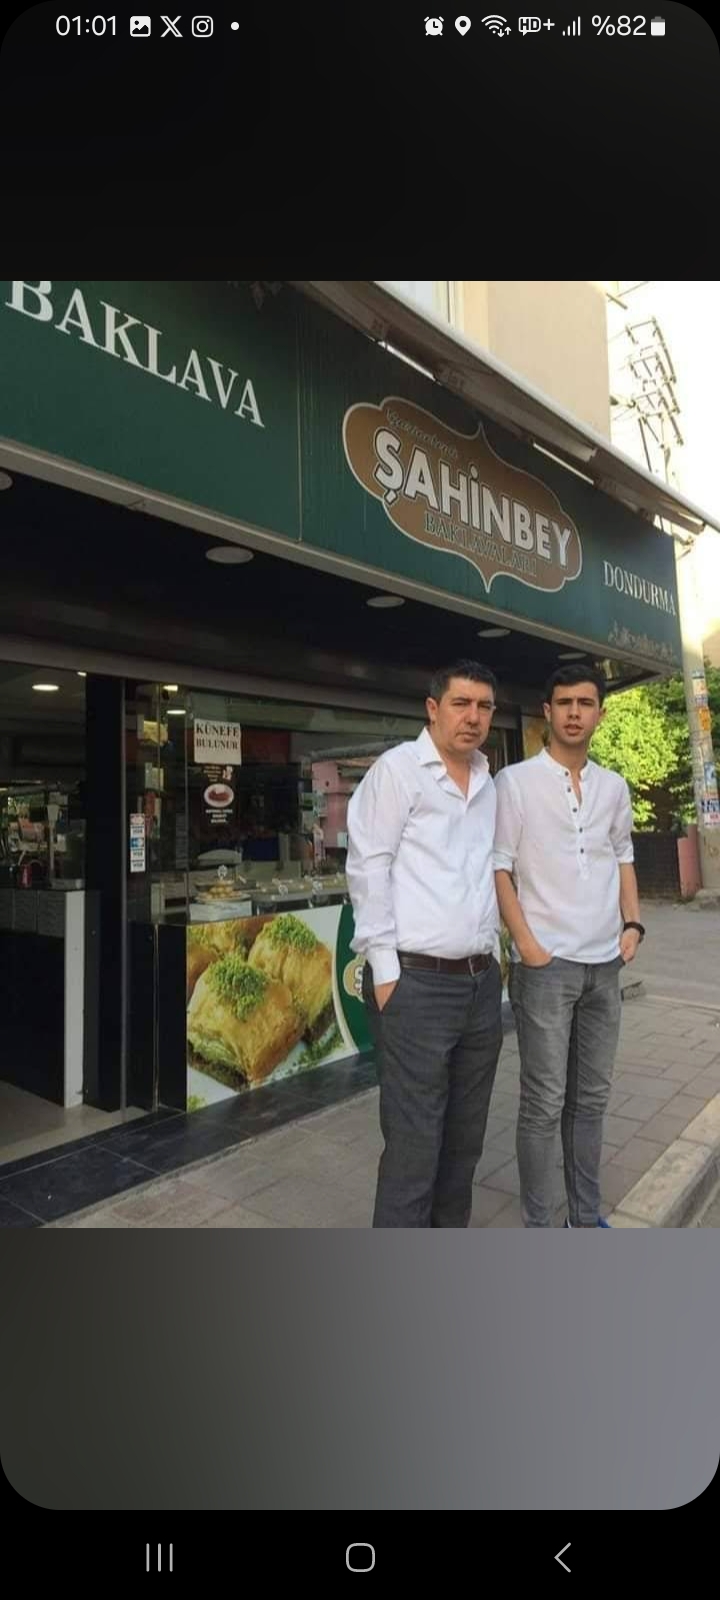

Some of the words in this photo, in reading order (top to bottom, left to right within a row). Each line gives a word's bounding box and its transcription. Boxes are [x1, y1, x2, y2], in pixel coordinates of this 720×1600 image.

[5, 281, 266, 428] BAKLAVA
[424, 510, 538, 577] BAKLAVALARI
[603, 559, 677, 616] DONDURMA
[195, 721, 240, 738] KÜNEFE
[195, 737, 239, 750] BULUNUR
